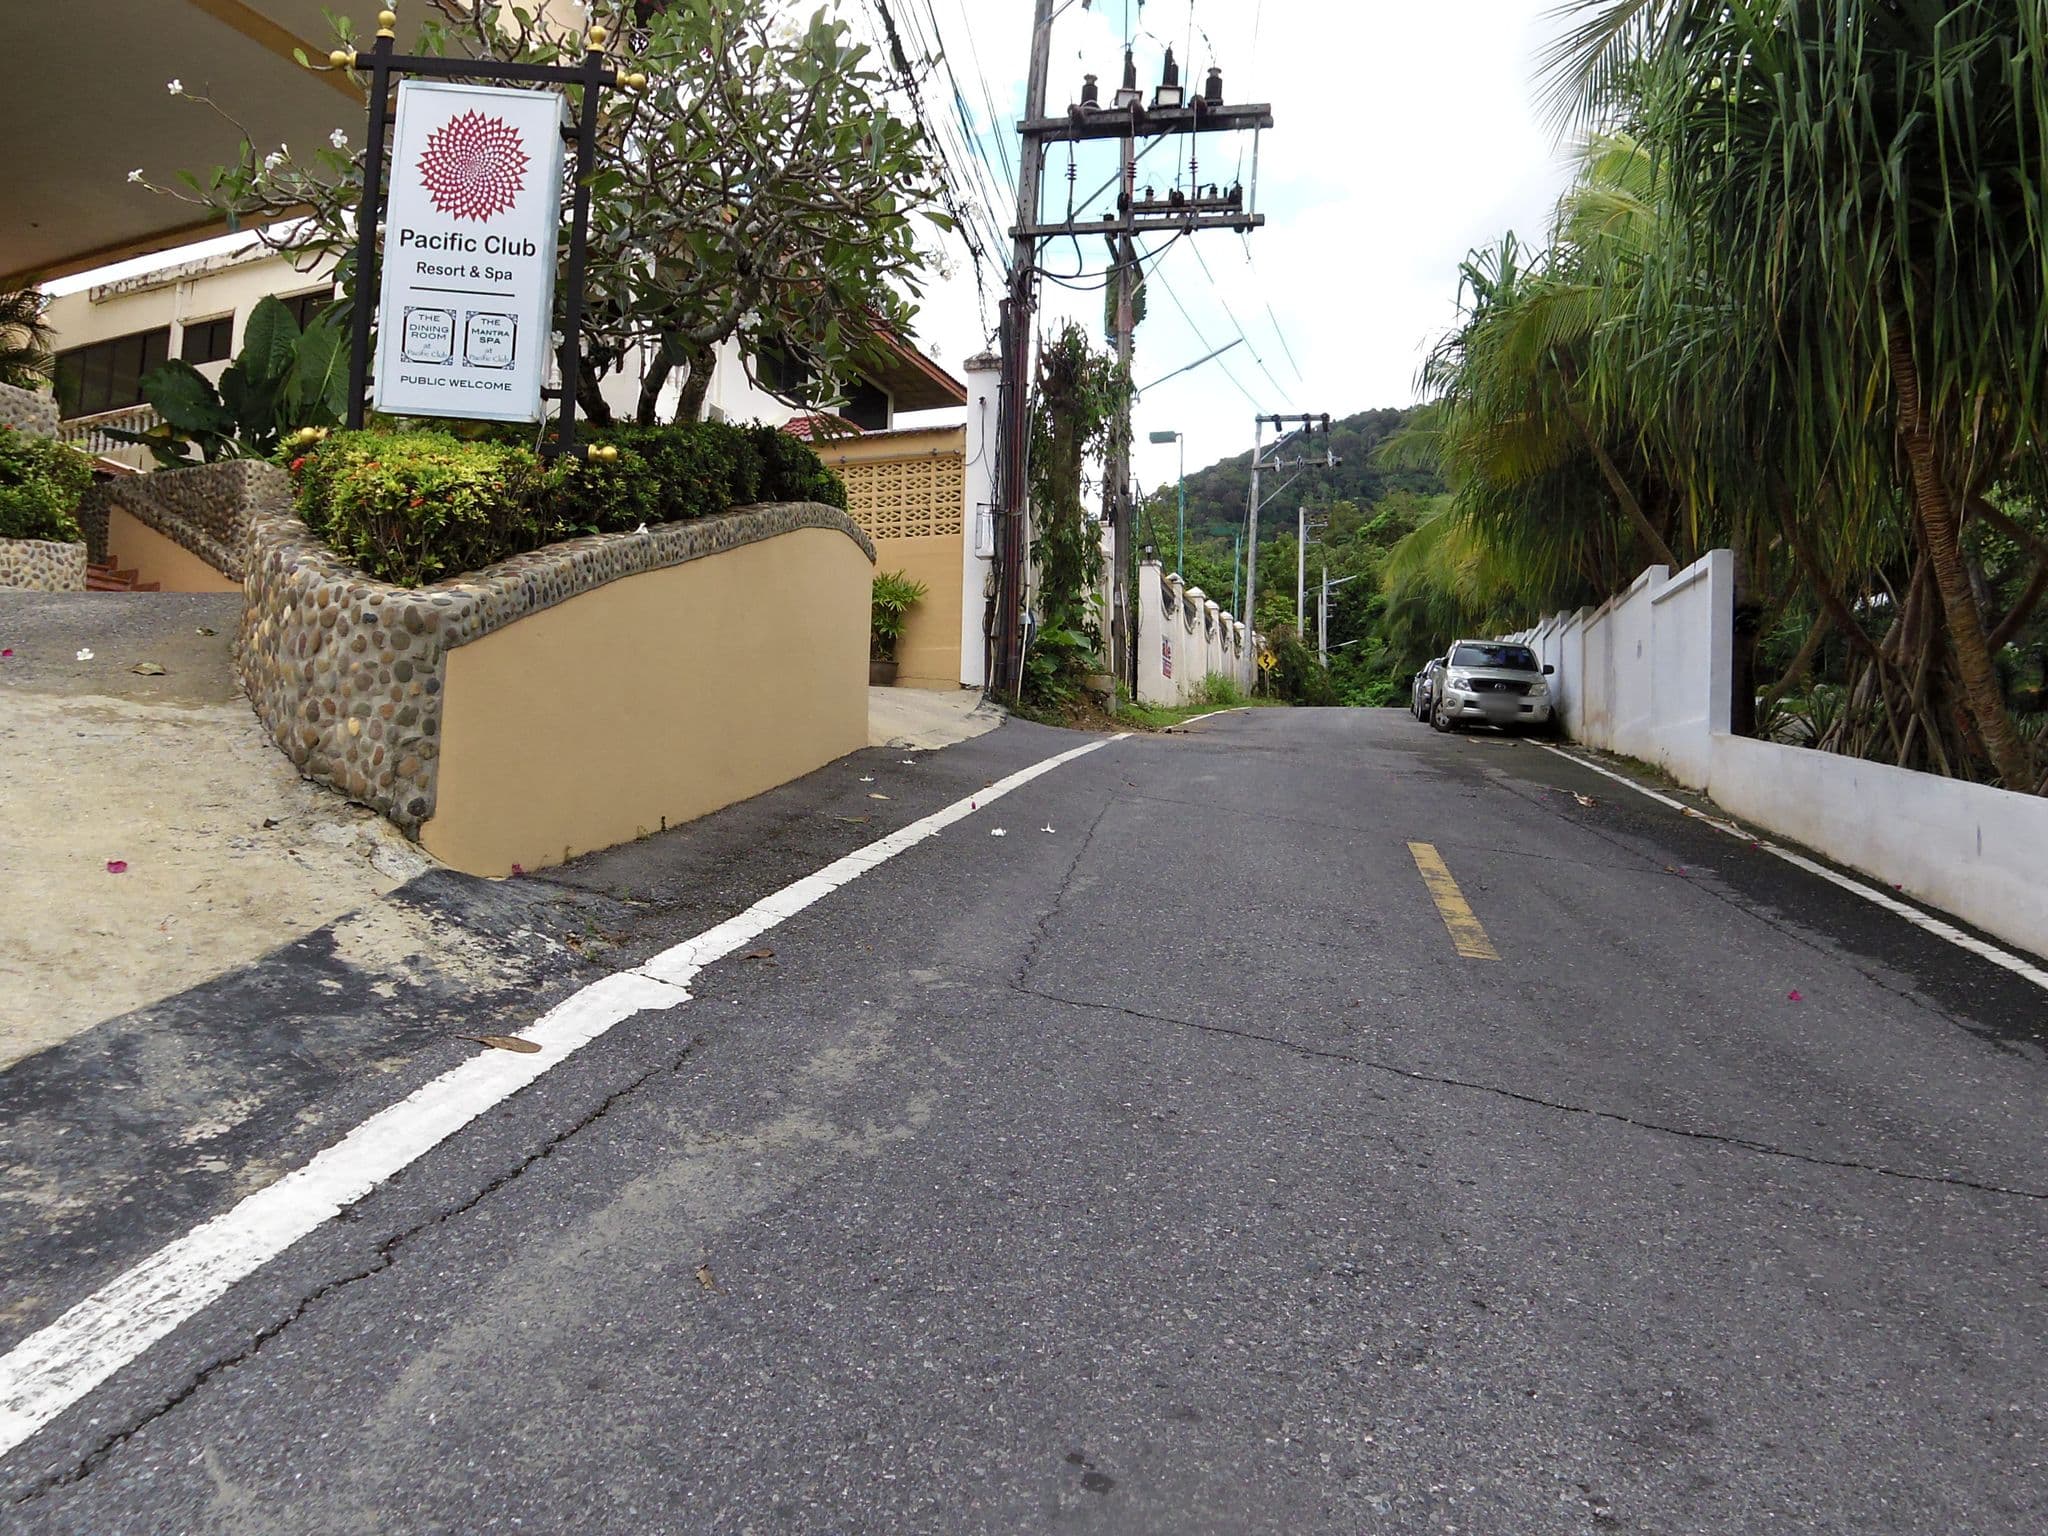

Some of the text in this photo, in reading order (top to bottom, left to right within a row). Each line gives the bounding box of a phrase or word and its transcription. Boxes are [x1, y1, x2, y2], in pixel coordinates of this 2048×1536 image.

[400, 229, 536, 257] Pacific Club
[416, 261, 513, 282] Resort & Spa
[418, 314, 440, 322] THE
[481, 318, 500, 326] THE
[410, 324, 449, 333] DINING
[472, 328, 509, 337] MANTRA
[411, 332, 447, 340] ROOM
[400, 375, 512, 391] PUBLIC WELCOME
